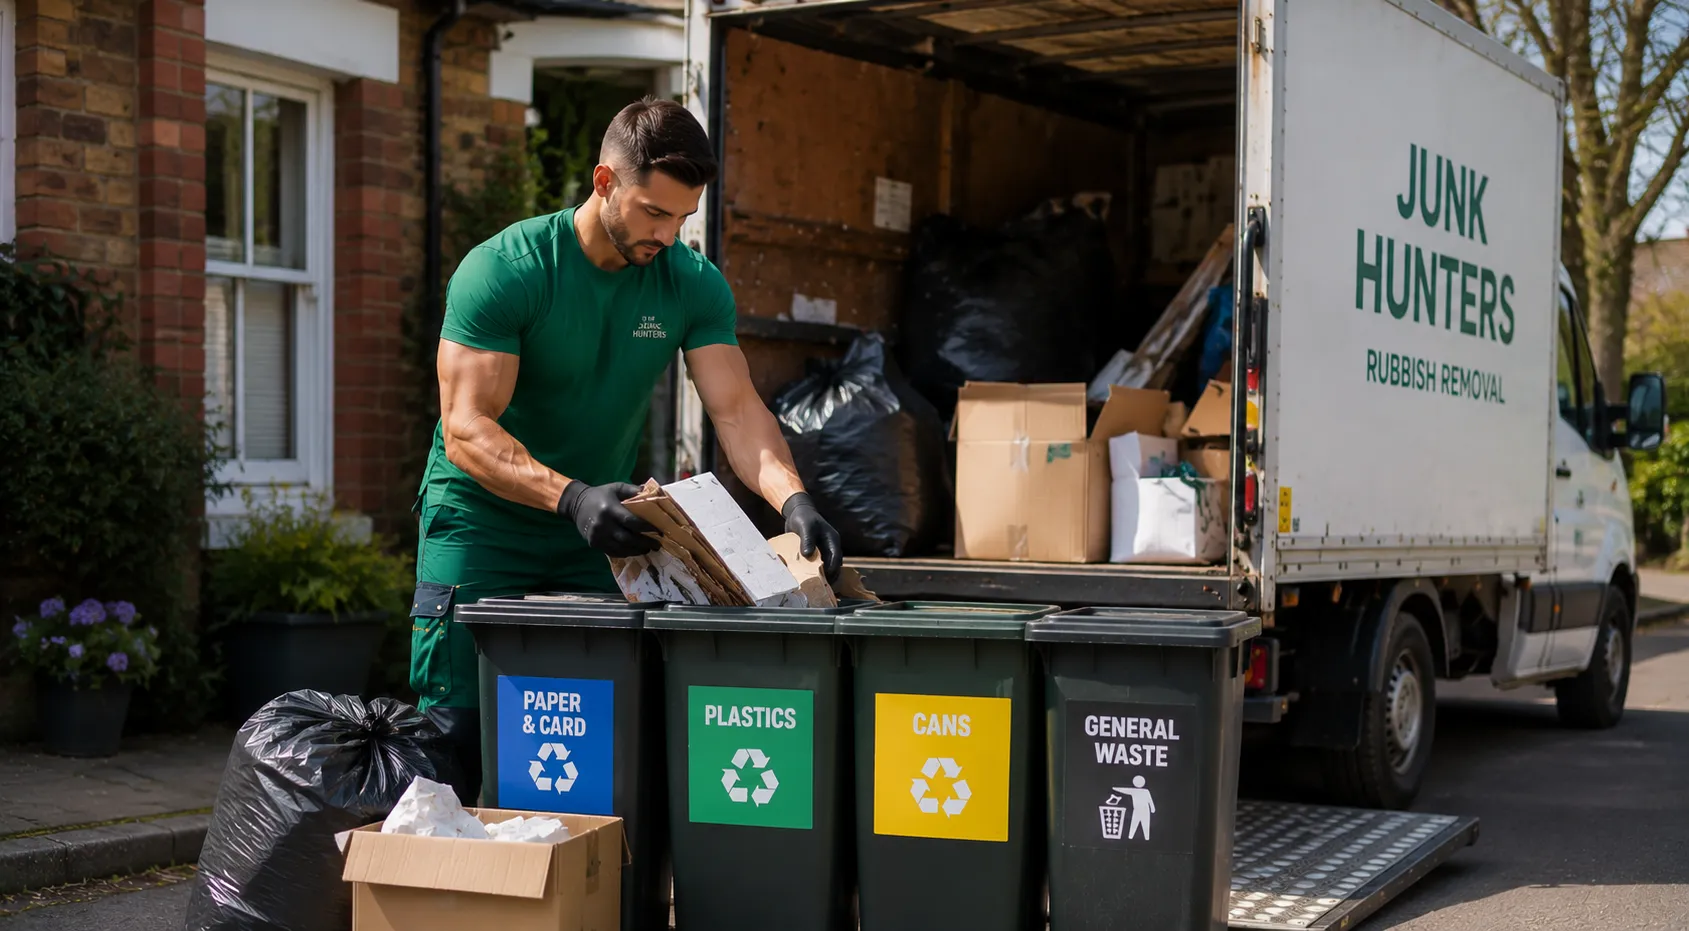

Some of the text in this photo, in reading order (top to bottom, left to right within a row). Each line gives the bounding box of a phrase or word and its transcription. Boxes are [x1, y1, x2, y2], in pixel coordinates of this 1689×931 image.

[1396, 143, 1488, 246] JUNK
[1355, 229, 1515, 344] HUNTERS
[632, 330, 667, 338] HUNTERS
[1366, 348, 1506, 405] RUBBISH REMOVAL
[523, 690, 581, 713] PAPER
[522, 715, 587, 737] & CARD
[705, 704, 797, 729] PLASTICS
[912, 712, 971, 737] CANS
[1084, 714, 1180, 740] GENERAL
[1094, 742, 1169, 767] WASTE
